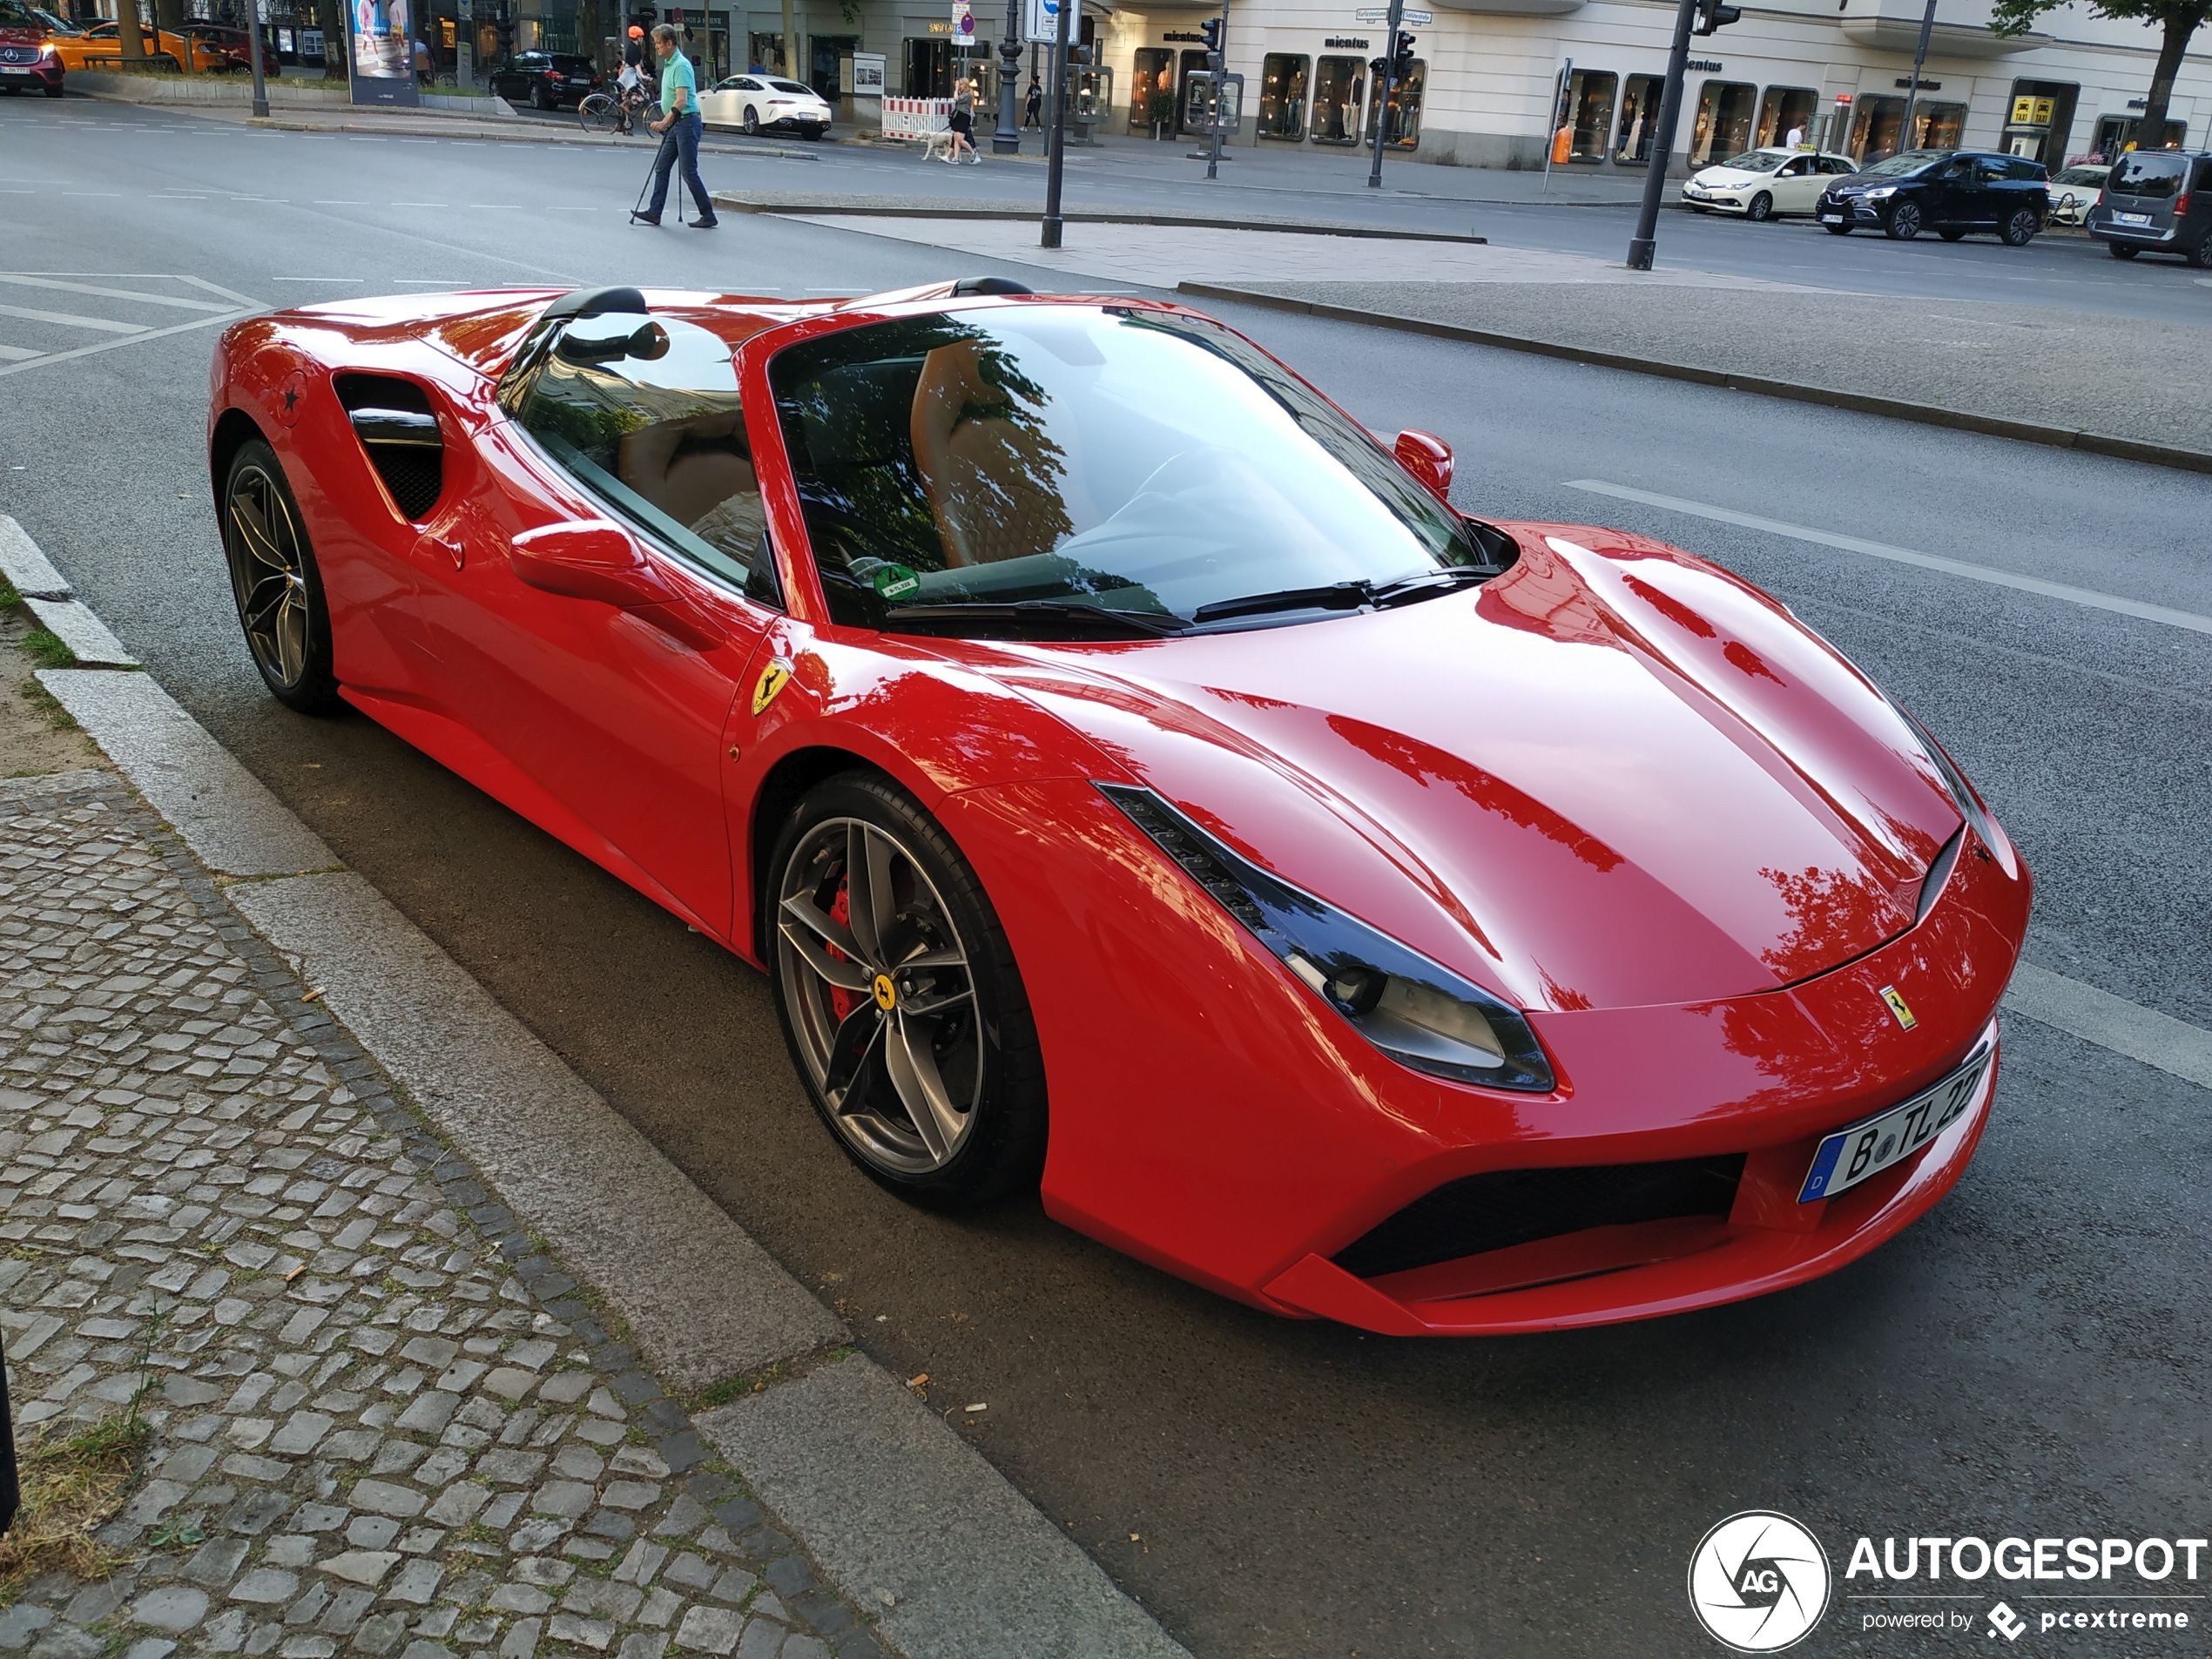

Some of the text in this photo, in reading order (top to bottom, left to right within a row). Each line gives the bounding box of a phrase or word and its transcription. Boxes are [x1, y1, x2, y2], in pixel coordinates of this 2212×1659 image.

[1163, 30, 1202, 43] mientus
[1325, 35, 1369, 49] mientus
[2015, 113, 2027, 122] TAXI
[2035, 114, 2047, 123] TAXI
[888, 567, 901, 582] 4
[1845, 1128, 1880, 1182] B
[1898, 1100, 1933, 1156] TL
[1811, 1176, 1823, 1190] D
